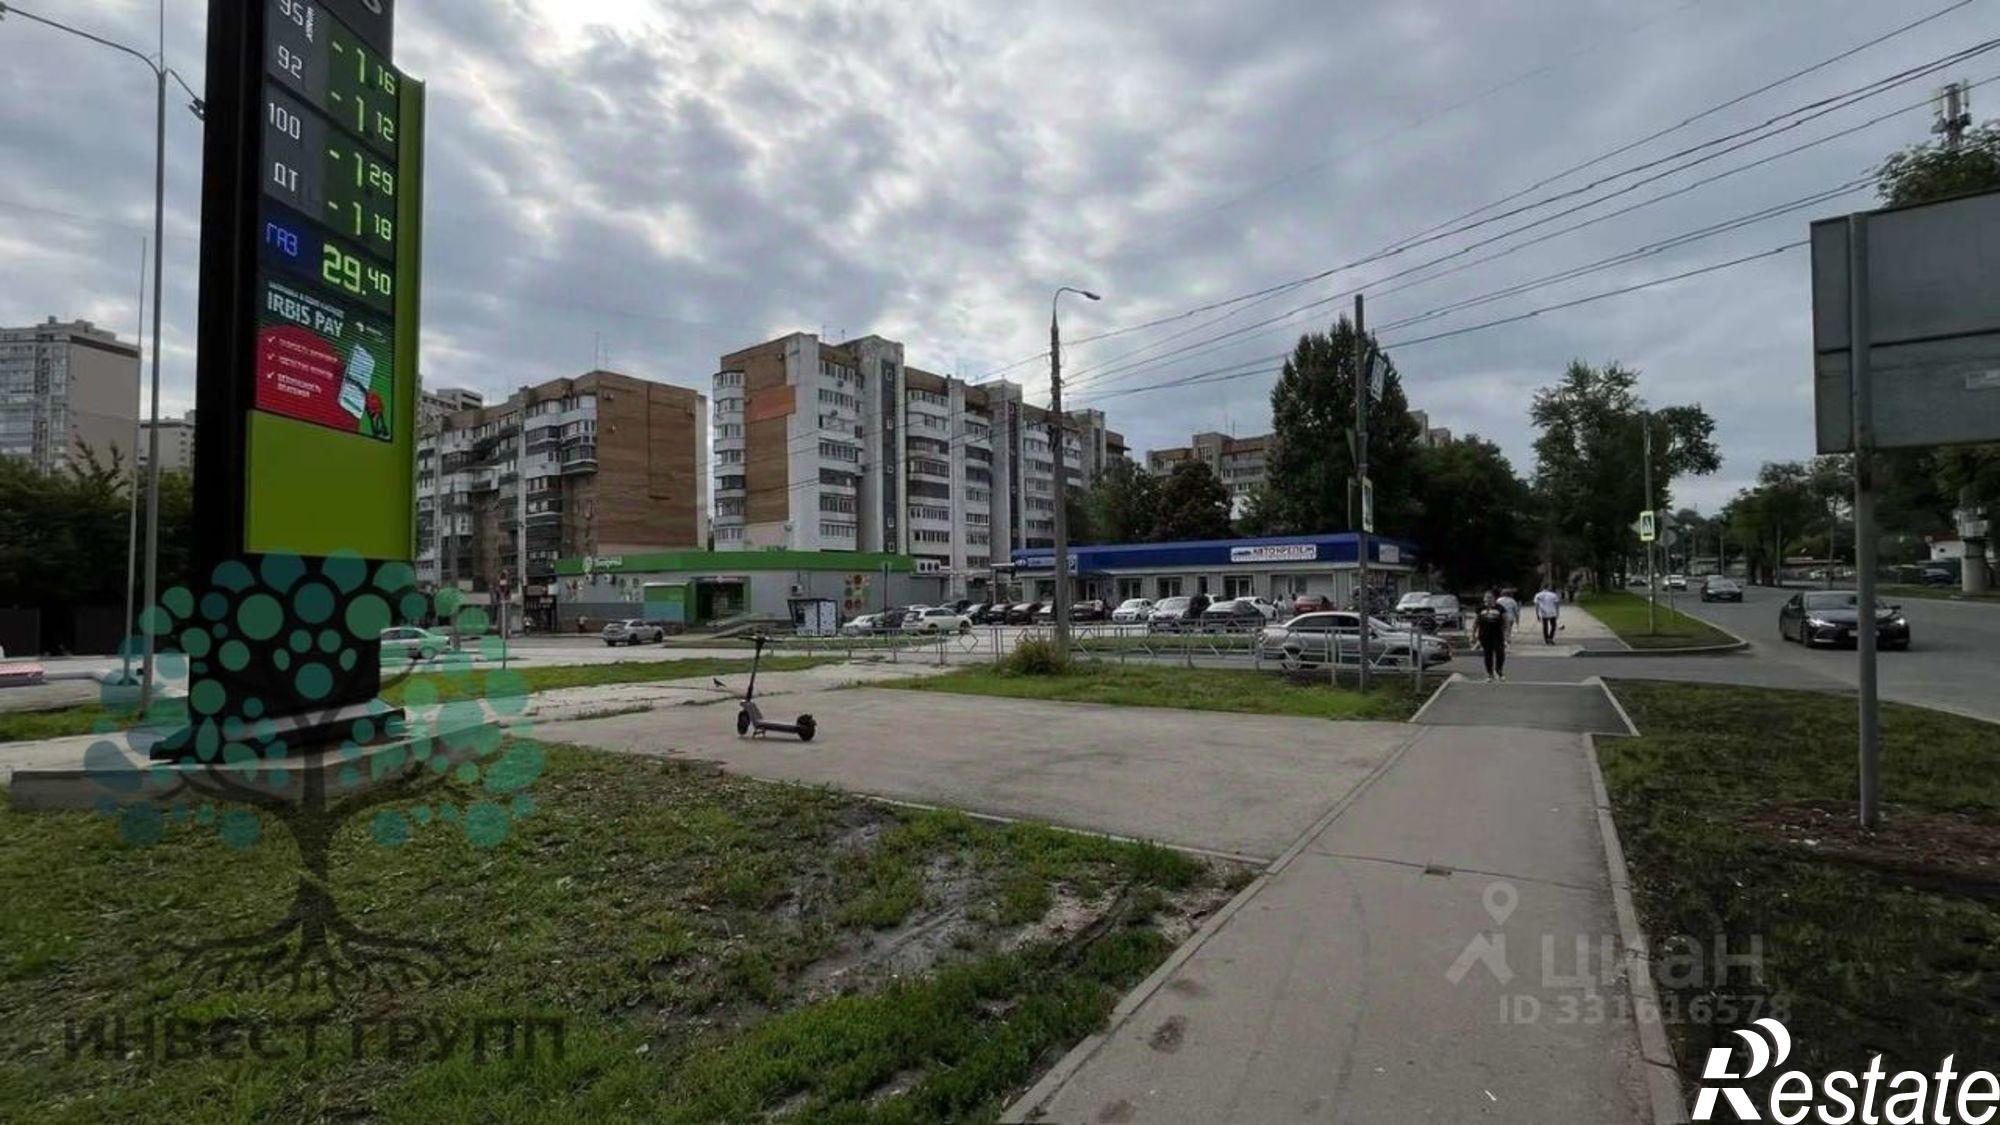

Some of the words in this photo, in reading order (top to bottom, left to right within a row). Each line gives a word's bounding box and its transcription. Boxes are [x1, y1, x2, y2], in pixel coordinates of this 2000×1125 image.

[279, 0, 304, 26] 95
[278, 45, 302, 79] 92
[377, 65, 395, 96] 16
[268, 102, 300, 140] 100
[376, 111, 394, 142] 12
[273, 162, 298, 192] ДТ
[369, 163, 393, 196] 29
[265, 222, 298, 257] ГАЗ
[374, 213, 392, 242] 18
[267, 290, 311, 328] IRBIS
[314, 310, 344, 338] PAY
